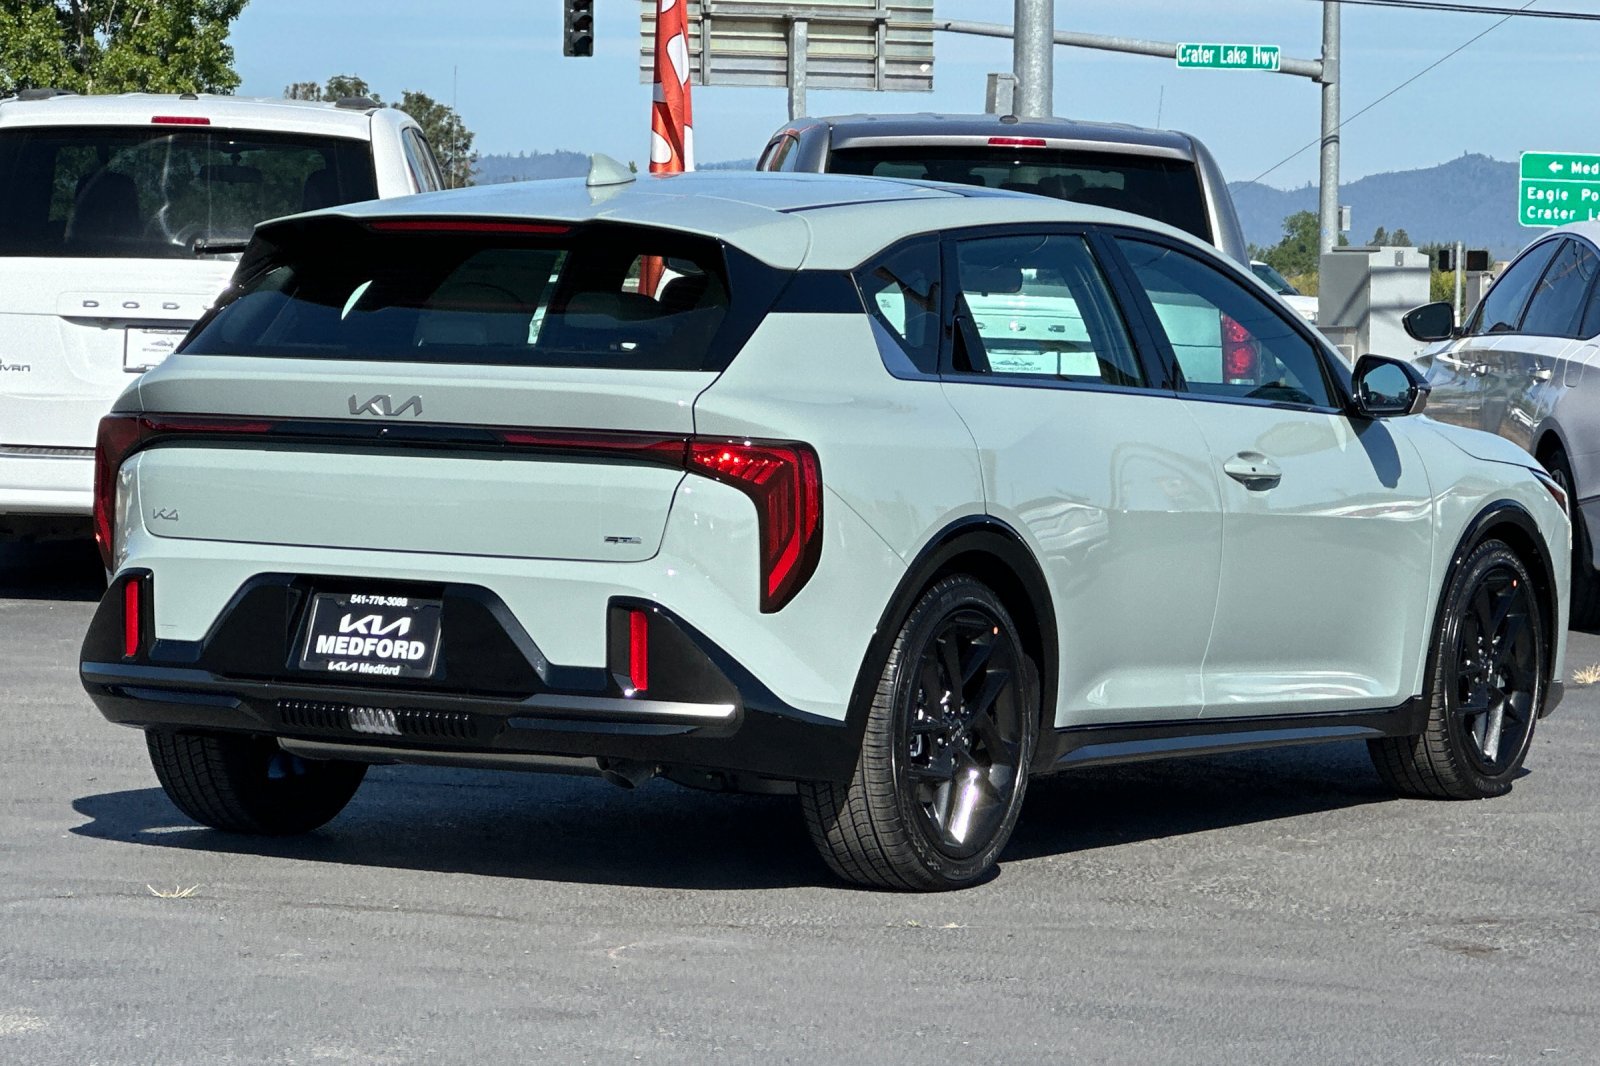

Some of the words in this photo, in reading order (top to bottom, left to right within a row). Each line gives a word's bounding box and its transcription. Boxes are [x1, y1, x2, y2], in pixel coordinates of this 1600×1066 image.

[1179, 44, 1215, 64] Crater
[1220, 46, 1248, 65] Lake
[1252, 46, 1279, 69] Hwy
[1571, 161, 1600, 175] Med
[1527, 186, 1569, 204] Eagle
[1581, 188, 1600, 202] Po
[1526, 205, 1577, 220] Crater
[348, 394, 423, 417] KIA
[153, 508, 179, 521] K4
[339, 613, 411, 637] KIA
[315, 635, 426, 660] MEDFORD
[327, 661, 359, 672] KIA
[359, 662, 401, 676] Medford
